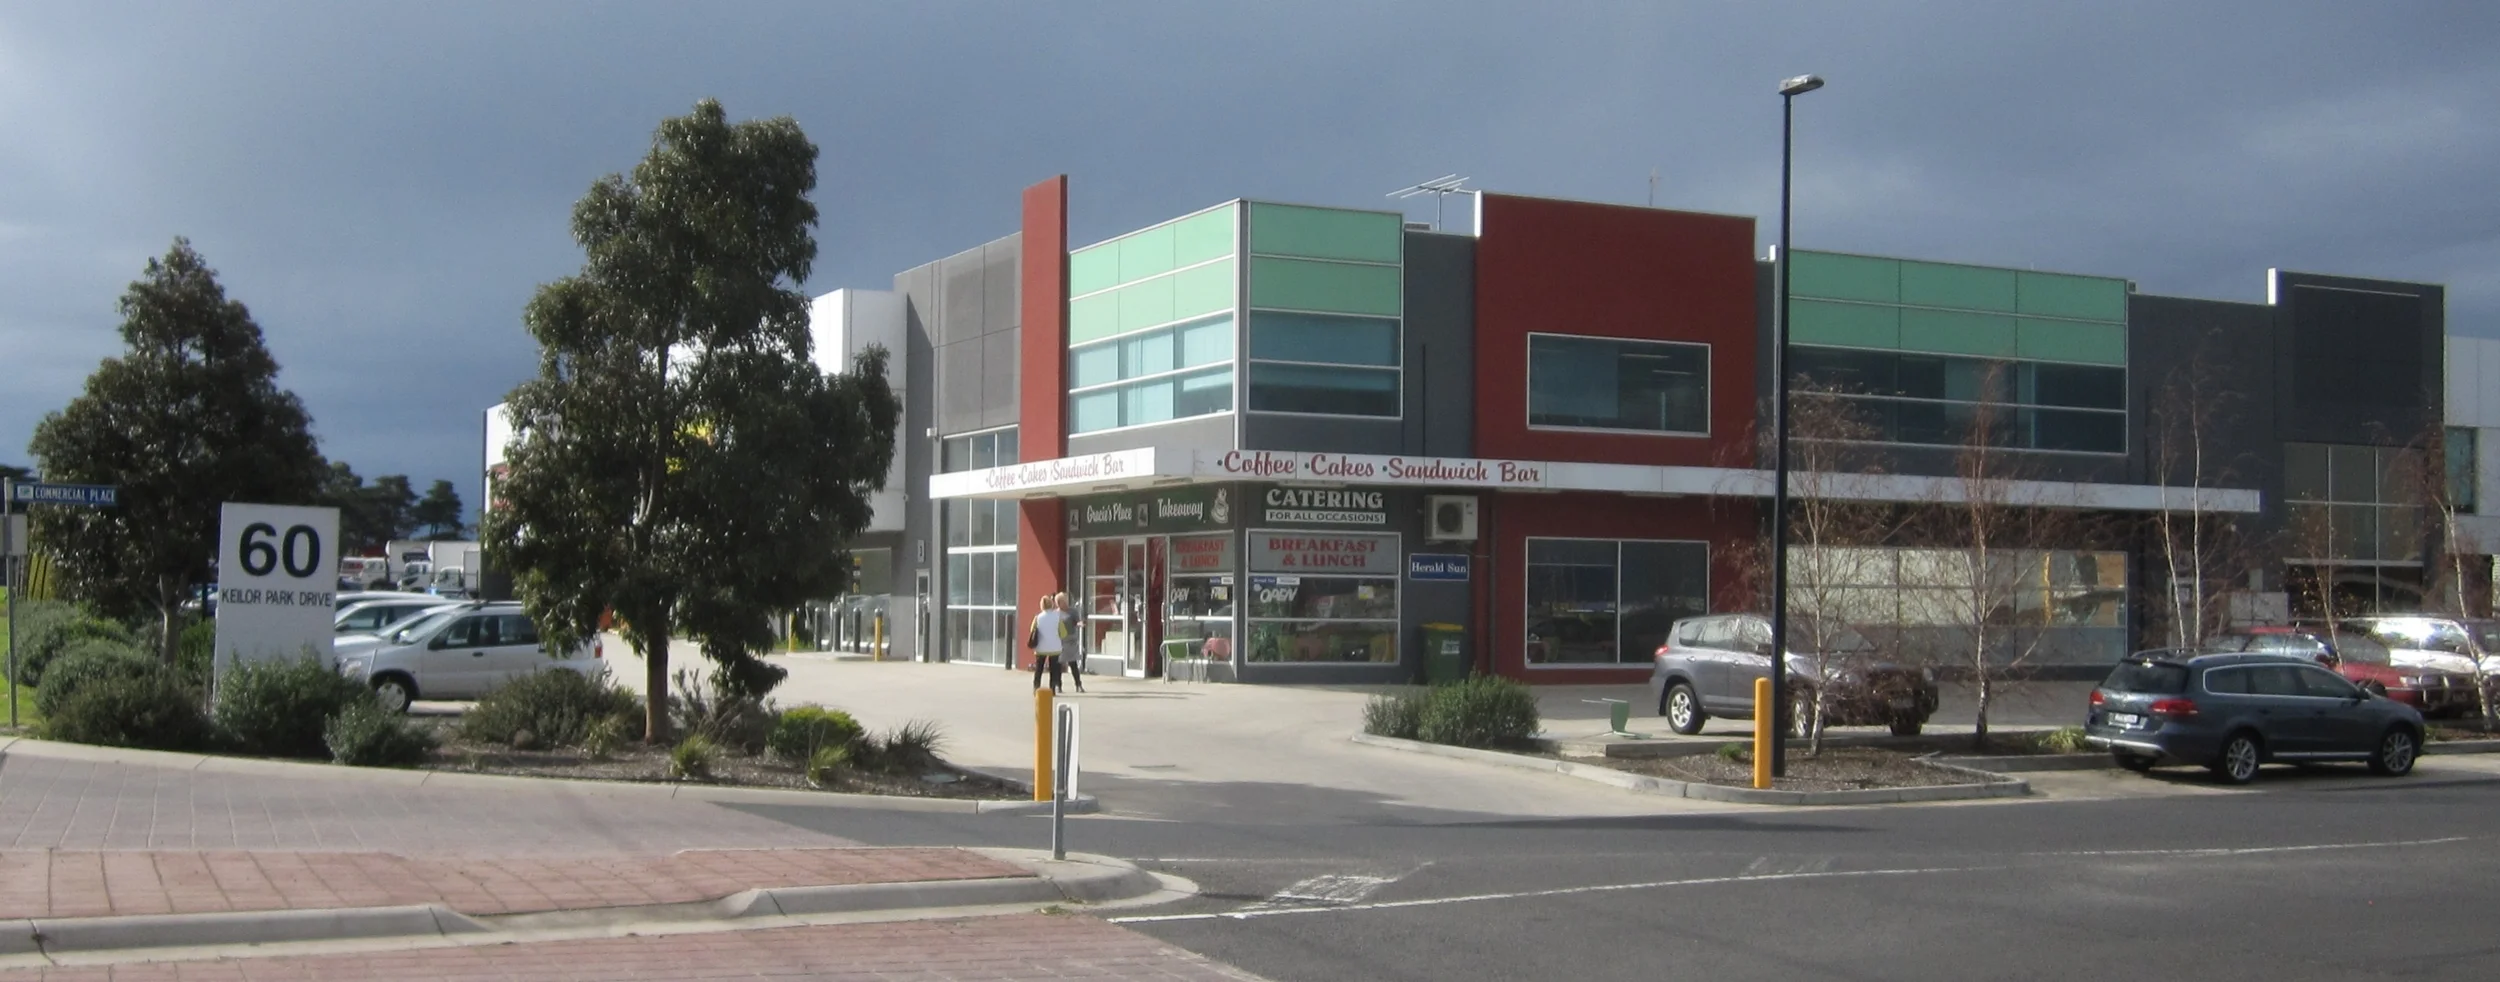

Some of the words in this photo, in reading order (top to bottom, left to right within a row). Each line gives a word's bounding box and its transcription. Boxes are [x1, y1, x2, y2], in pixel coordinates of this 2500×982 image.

[988, 468, 1016, 489] Coffee
[1020, 464, 1047, 486] Cakes
[1052, 457, 1099, 481] Sandwich
[1103, 454, 1124, 476] Bar
[1223, 450, 1295, 476] Coffee
[1310, 453, 1374, 477] Cakes
[1388, 457, 1489, 481] Sandwich
[1498, 461, 1540, 482] Bar
[35, 486, 86, 501] COMMERCIAL
[1266, 488, 1383, 509] CATERING
[1086, 504, 1113, 523] Gracie's
[1113, 502, 1133, 520] Place
[1157, 498, 1203, 518] Takeaway
[1269, 511, 1290, 521] FOR
[1293, 511, 1313, 521] ALL
[1316, 512, 1384, 523] OCCASIONS!
[239, 522, 321, 578] 60
[1268, 538, 1379, 552] BREAKFAST
[1282, 554, 1296, 567] &
[1302, 554, 1366, 567] LUNCH
[1411, 561, 1444, 573] Herald
[1447, 563, 1468, 576] Sun
[221, 588, 261, 604] KEILOR
[265, 589, 295, 605] PARK
[299, 592, 333, 607] DRIVE
[1260, 586, 1299, 603] OPEN
